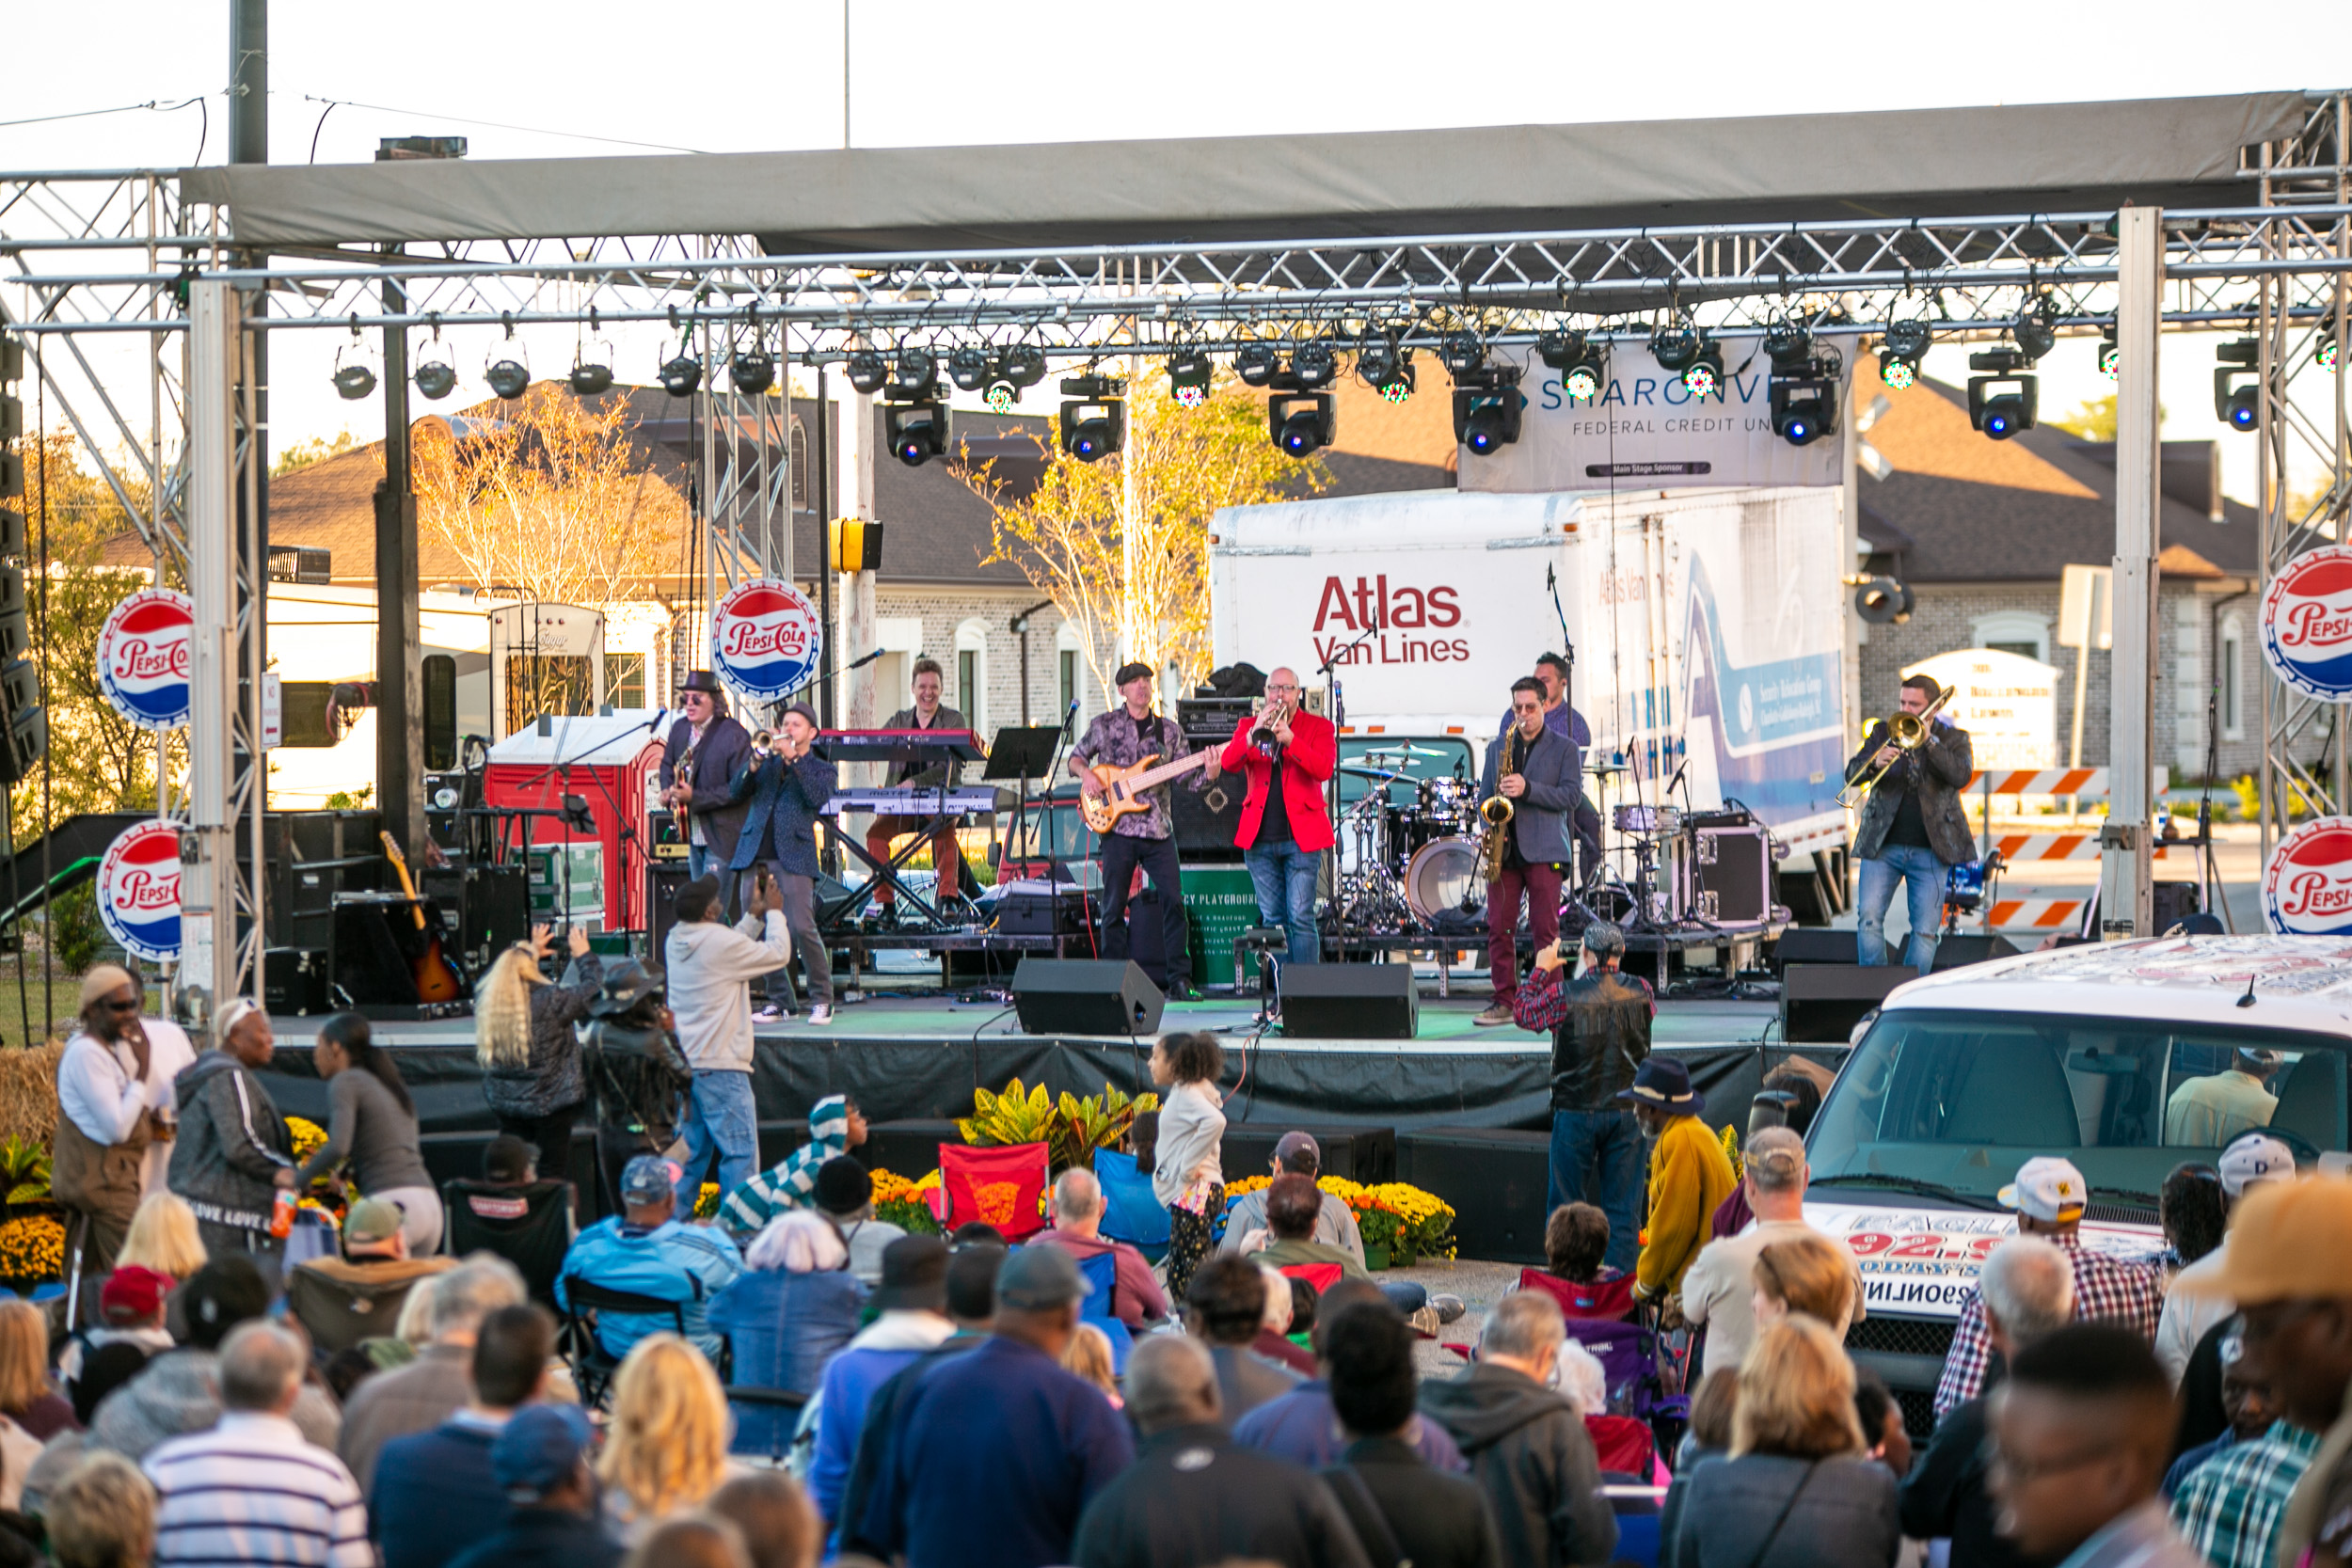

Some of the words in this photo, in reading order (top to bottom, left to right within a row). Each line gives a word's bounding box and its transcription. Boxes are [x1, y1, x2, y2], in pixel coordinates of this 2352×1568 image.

[1573, 420, 1656, 436] FEDERAL
[1664, 418, 1735, 433] CREDIT
[1744, 418, 1771, 433] UN
[1613, 463, 1630, 474] Main
[1632, 463, 1653, 474] Stage
[1654, 463, 1683, 474] Sponsor
[1312, 574, 1461, 632] Atlas
[2281, 600, 2352, 647] PEPSI-
[1312, 635, 1373, 666] Van
[1380, 633, 1470, 664] Lines
[2283, 871, 2352, 918] PEPSI-
[1860, 1259, 1982, 1277] ODAY'S
